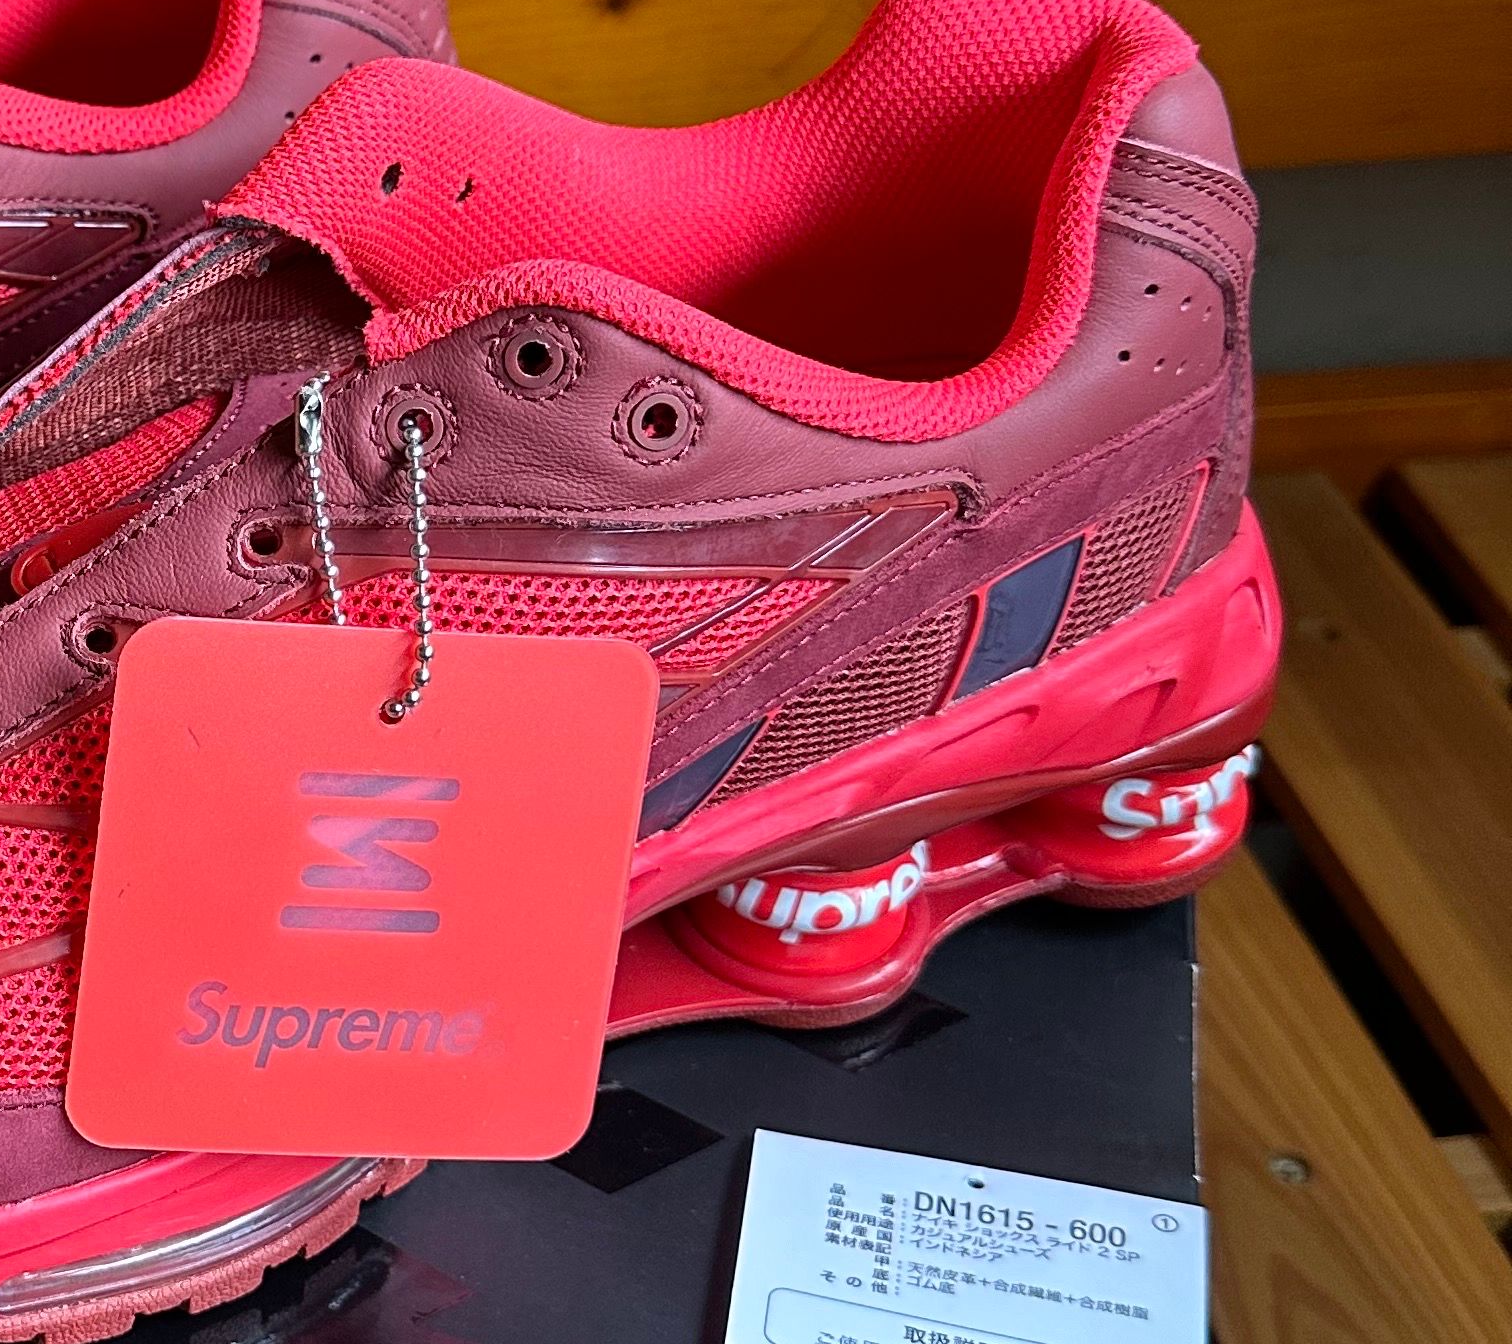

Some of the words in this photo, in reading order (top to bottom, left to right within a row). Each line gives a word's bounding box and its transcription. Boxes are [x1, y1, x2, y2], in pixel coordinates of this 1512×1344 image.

[177, 981, 484, 1069] Supreme
[913, 1190, 1035, 1232] DN1615
[1069, 1218, 1127, 1248] 600
[909, 1237, 1004, 1262] インドネシア
[906, 1275, 956, 1295] ゴム底
